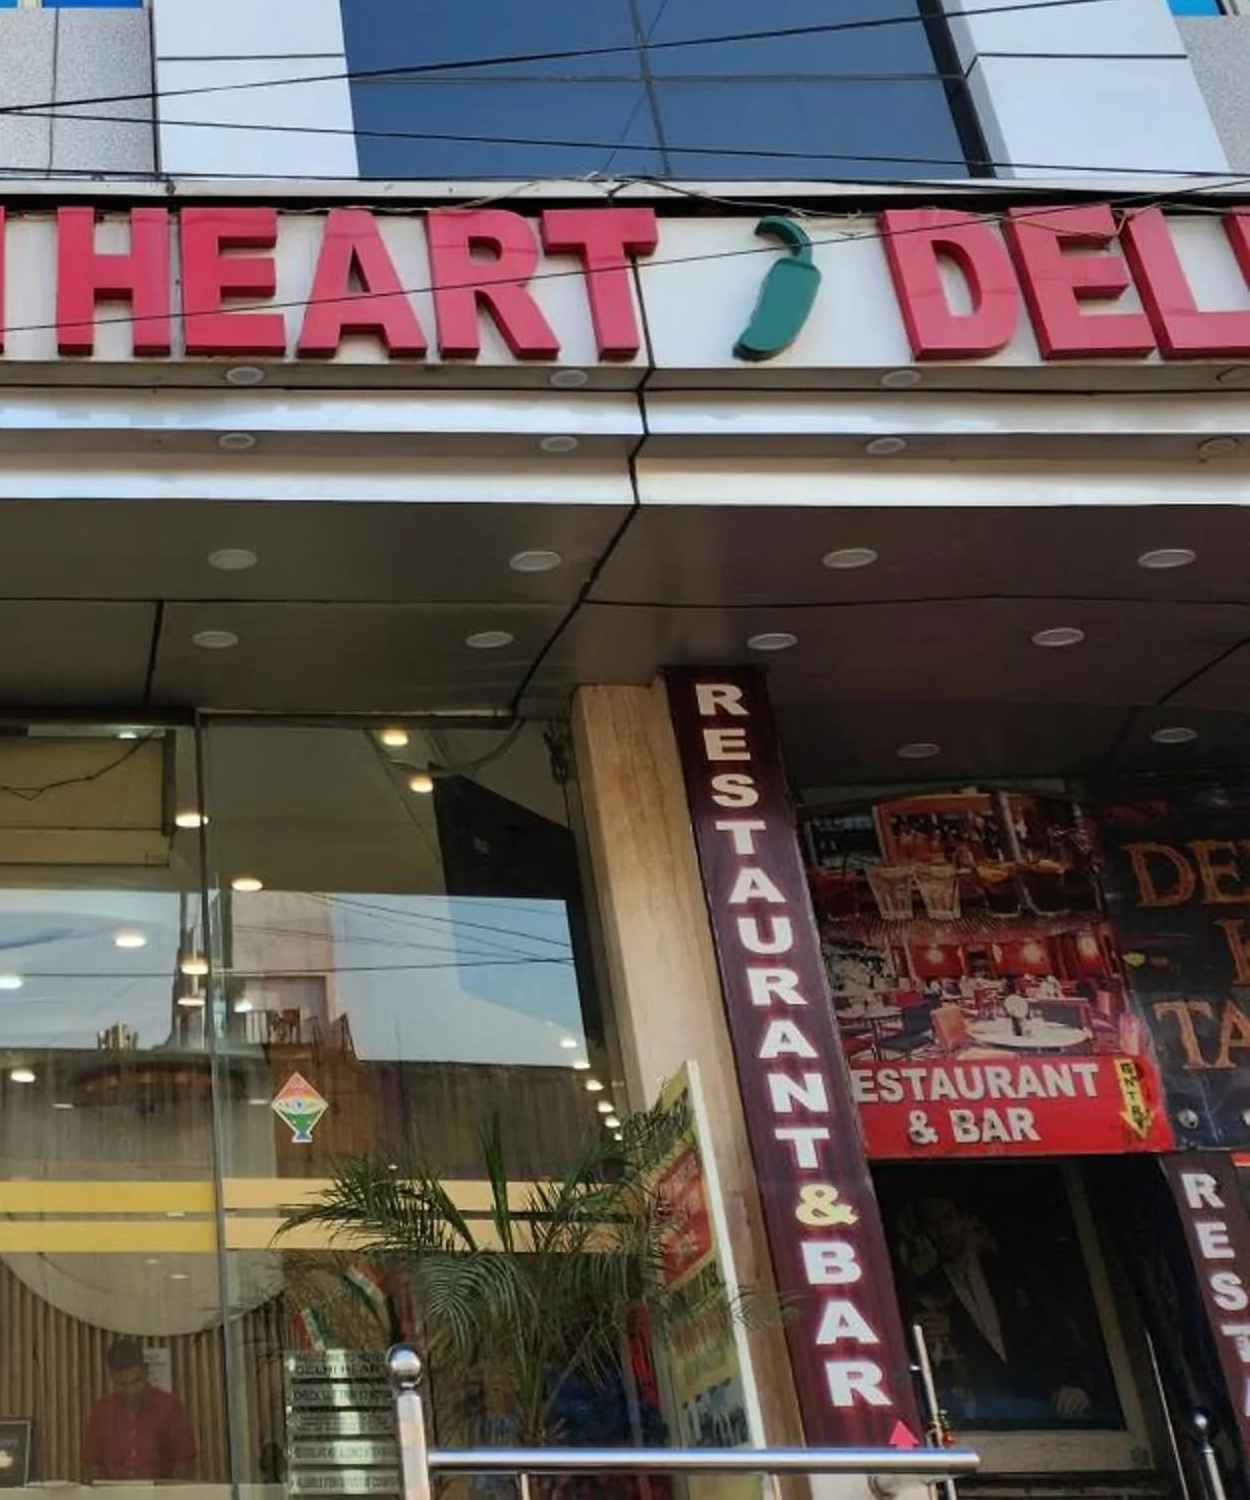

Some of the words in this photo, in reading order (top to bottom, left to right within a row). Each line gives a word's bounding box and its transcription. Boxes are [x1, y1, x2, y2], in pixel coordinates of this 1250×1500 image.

[56, 206, 659, 361] HEART
[877, 204, 1250, 361] DEL
[1120, 840, 1250, 907] DE
[851, 1062, 1100, 1103] ESTAURANT
[908, 1109, 939, 1145] &
[949, 1106, 1042, 1144] BAR
[1181, 1173, 1250, 1417] REST
